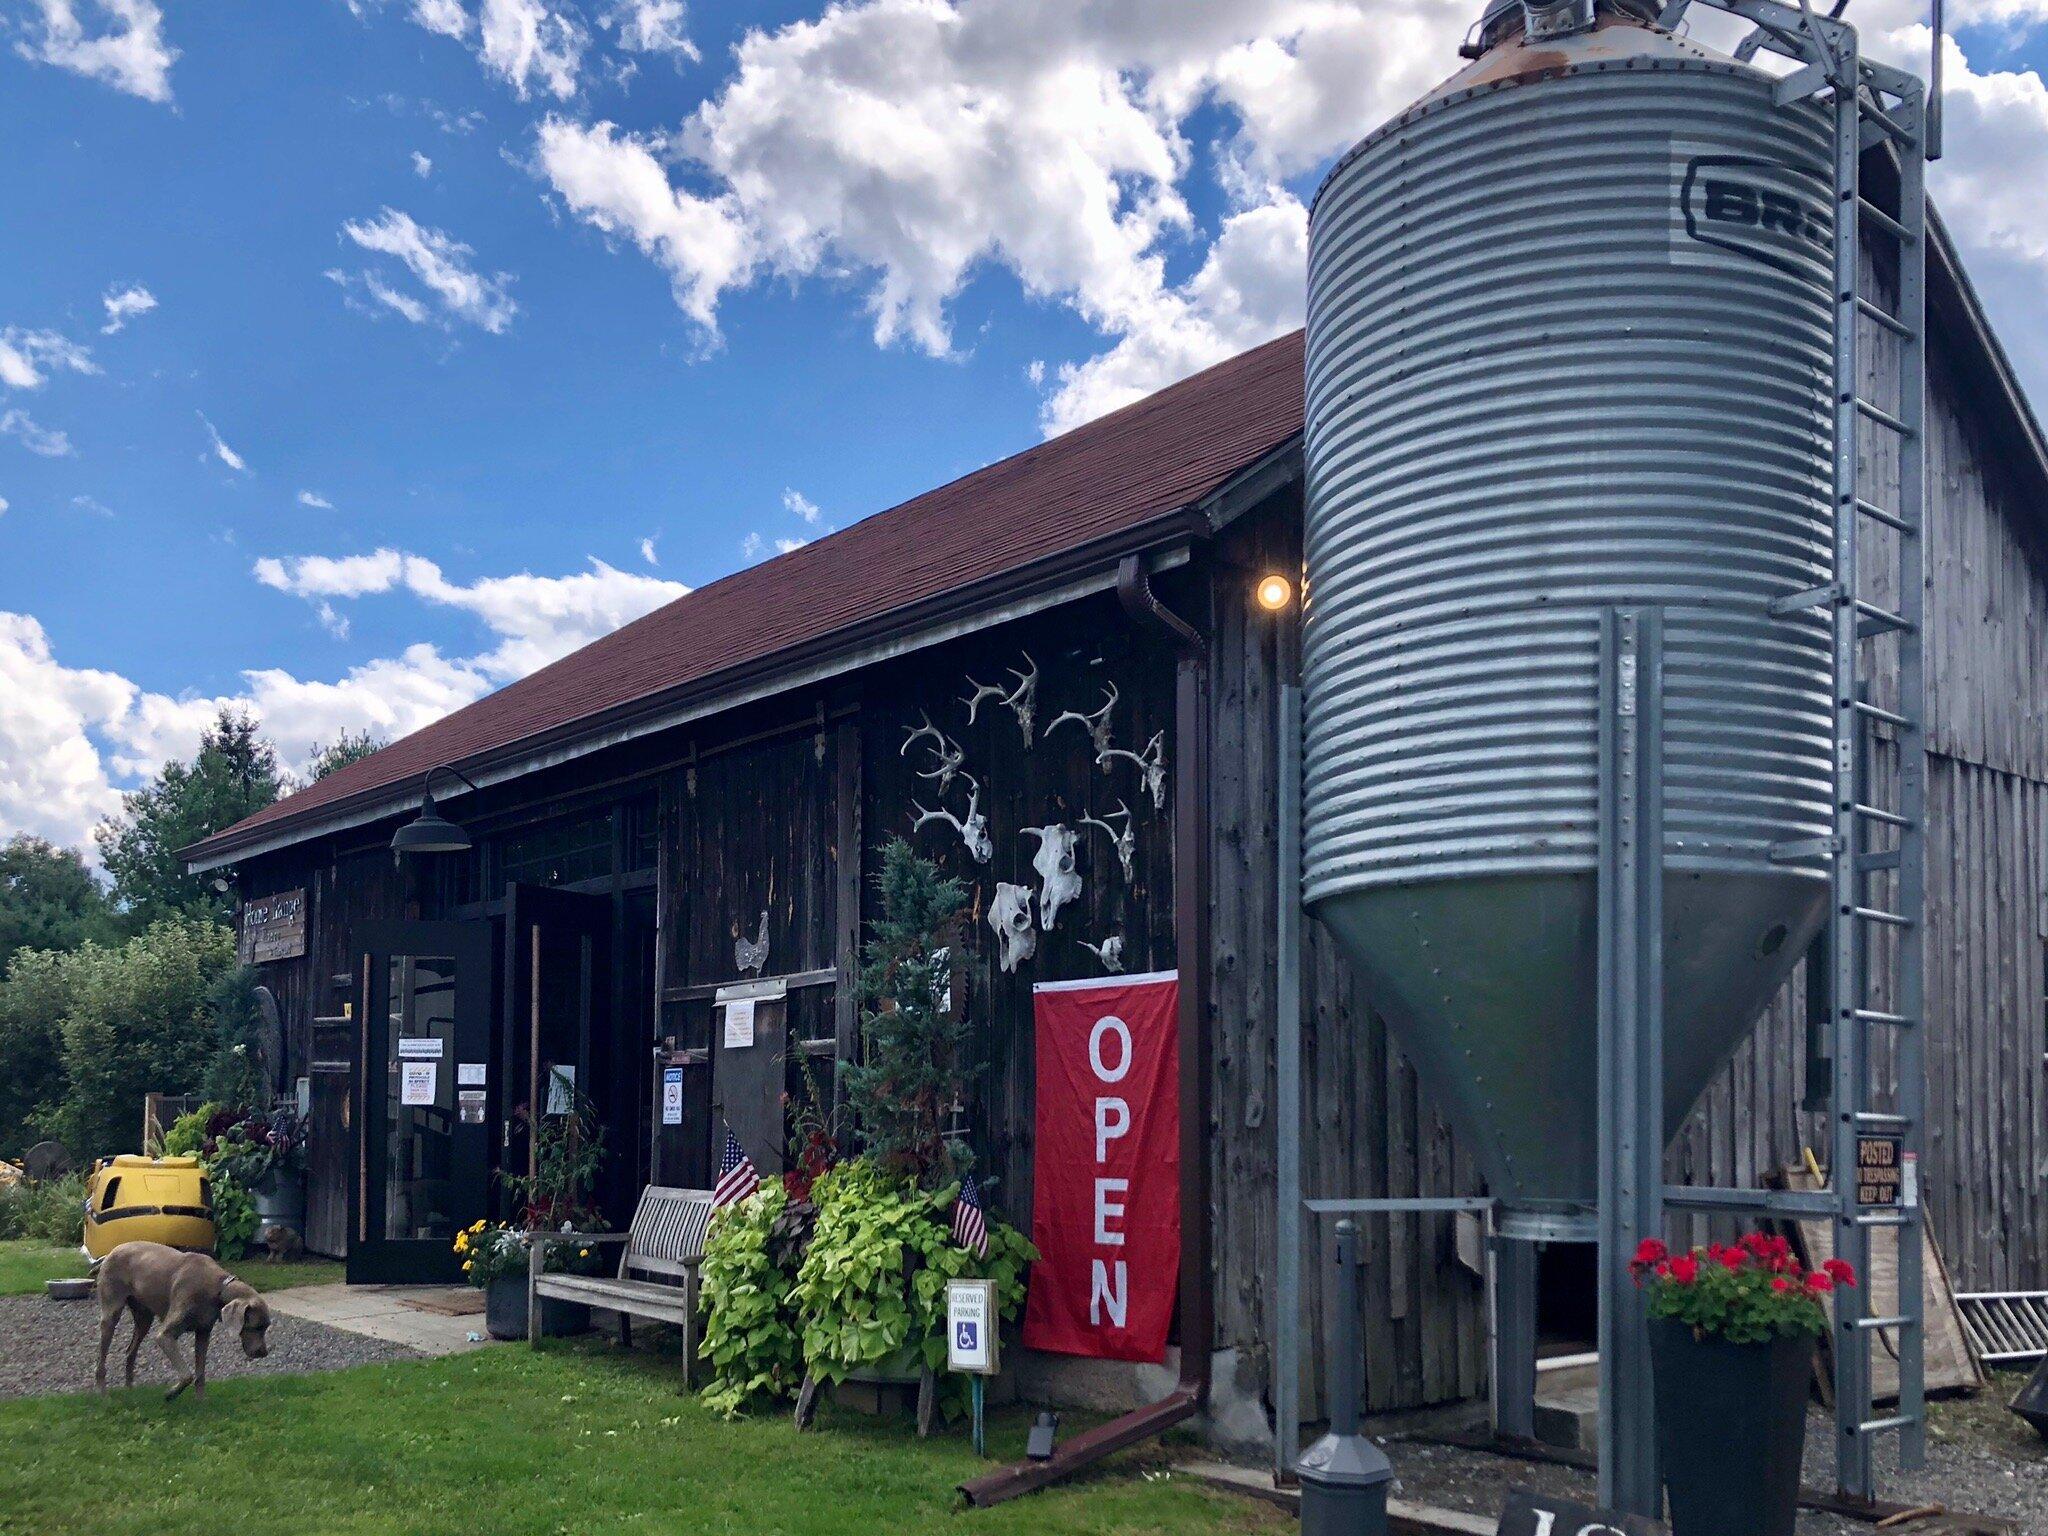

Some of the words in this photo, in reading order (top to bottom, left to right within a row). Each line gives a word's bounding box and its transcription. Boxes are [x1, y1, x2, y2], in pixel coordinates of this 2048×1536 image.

[667, 1072, 681, 1081] NOTICE
[1860, 1140, 1894, 1165] POSTED
[1088, 1015, 1132, 1328] OPEN
[1863, 1167, 1900, 1184] TRESPASSING
[1860, 1185, 1878, 1203] KEEP
[1879, 1185, 1893, 1203] OUT
[951, 1293, 983, 1303] RESERVED
[953, 1306, 981, 1317] PARKING
